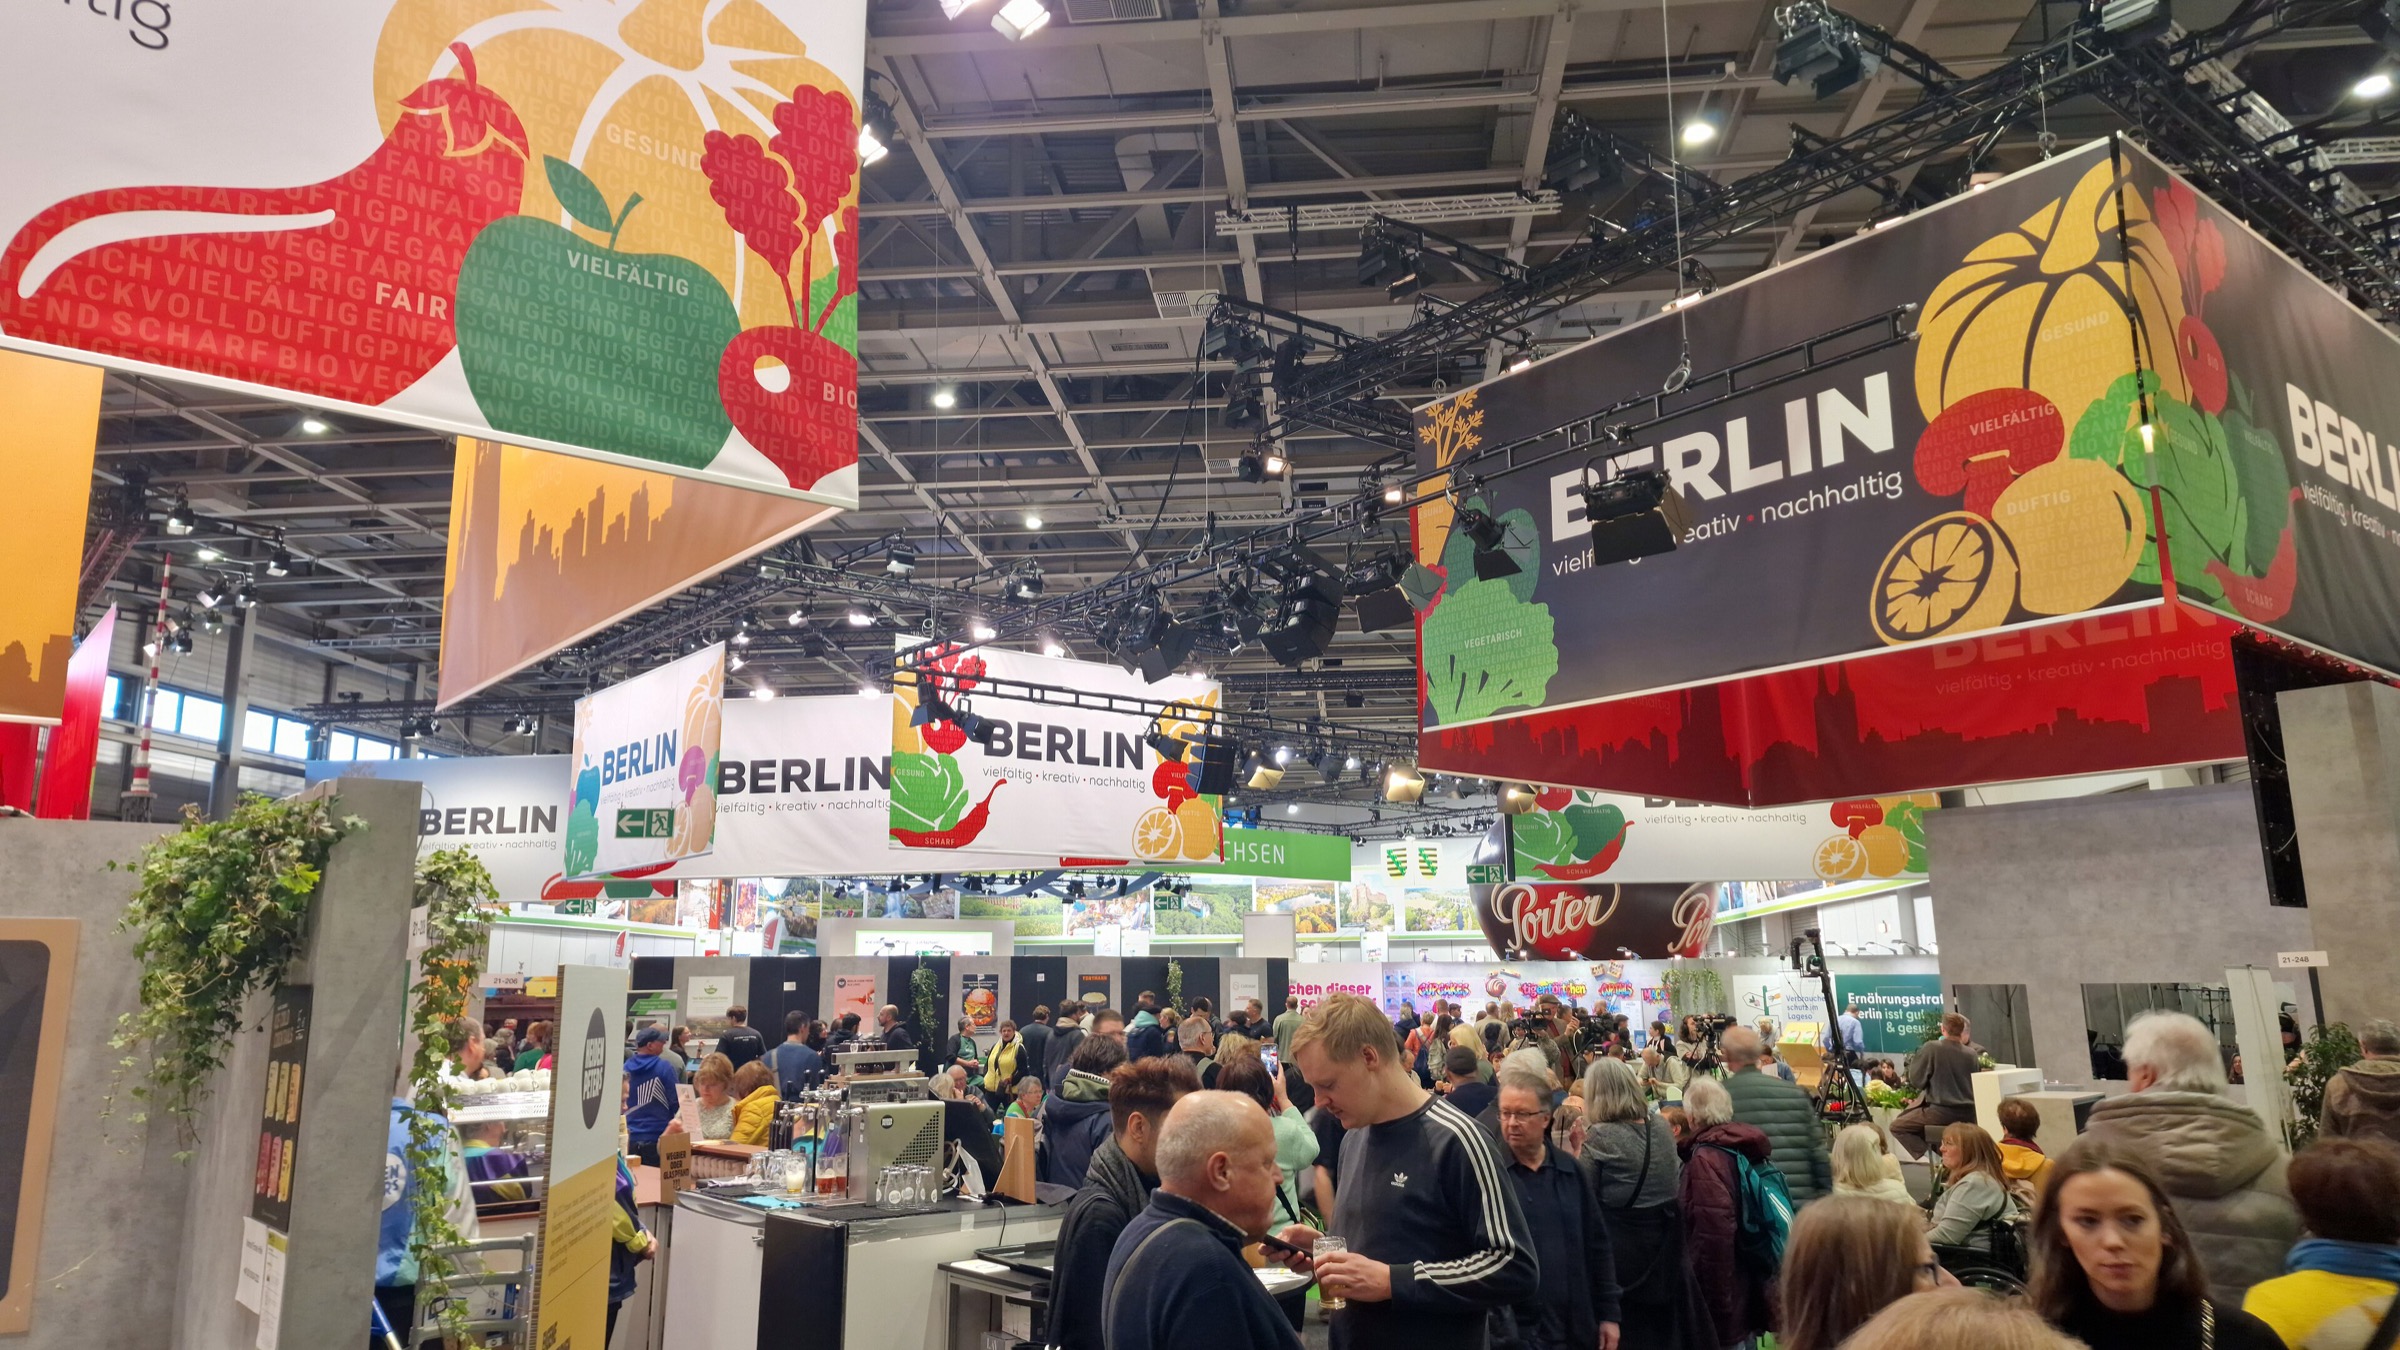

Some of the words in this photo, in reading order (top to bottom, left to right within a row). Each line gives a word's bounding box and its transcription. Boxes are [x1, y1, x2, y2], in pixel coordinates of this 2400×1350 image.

[606, 122, 701, 172] GESUND
[566, 249, 690, 297] VIELFÄLTIG
[375, 281, 448, 320] FAIR
[2041, 310, 2110, 343] GESUND
[1969, 403, 2055, 437] VIELFÄLTIG
[2286, 382, 2400, 514] BERLI
[1760, 470, 1903, 524] nachhaltig
[2006, 489, 2072, 516] DUFTIG
[1464, 628, 1523, 650] VEGETARISCH
[1936, 671, 2011, 696] vielfältig
[2028, 662, 2094, 682] kreativ
[2111, 640, 2226, 670] nachhaltig
[602, 729, 677, 787] BERLIN
[984, 718, 1145, 770] BERLIN
[717, 755, 891, 796] BERLIN
[896, 768, 925, 778] GESUND
[982, 766, 1033, 784] vielfältig
[1042, 772, 1081, 785] kreativ
[1089, 775, 1146, 793] nachhaltig
[418, 805, 557, 836] BERLIN
[775, 800, 817, 812] kreativ
[1644, 813, 1692, 827] vielfältig
[1701, 813, 1738, 824] kreativ
[1747, 813, 1807, 825] nachhaltig
[924, 837, 955, 846] SCHARF
[1491, 883, 1621, 951] Porter
[1857, 1008, 1882, 1019] erlin
[1885, 1008, 1903, 1019] isst
[670, 1160, 683, 1169] ODER
